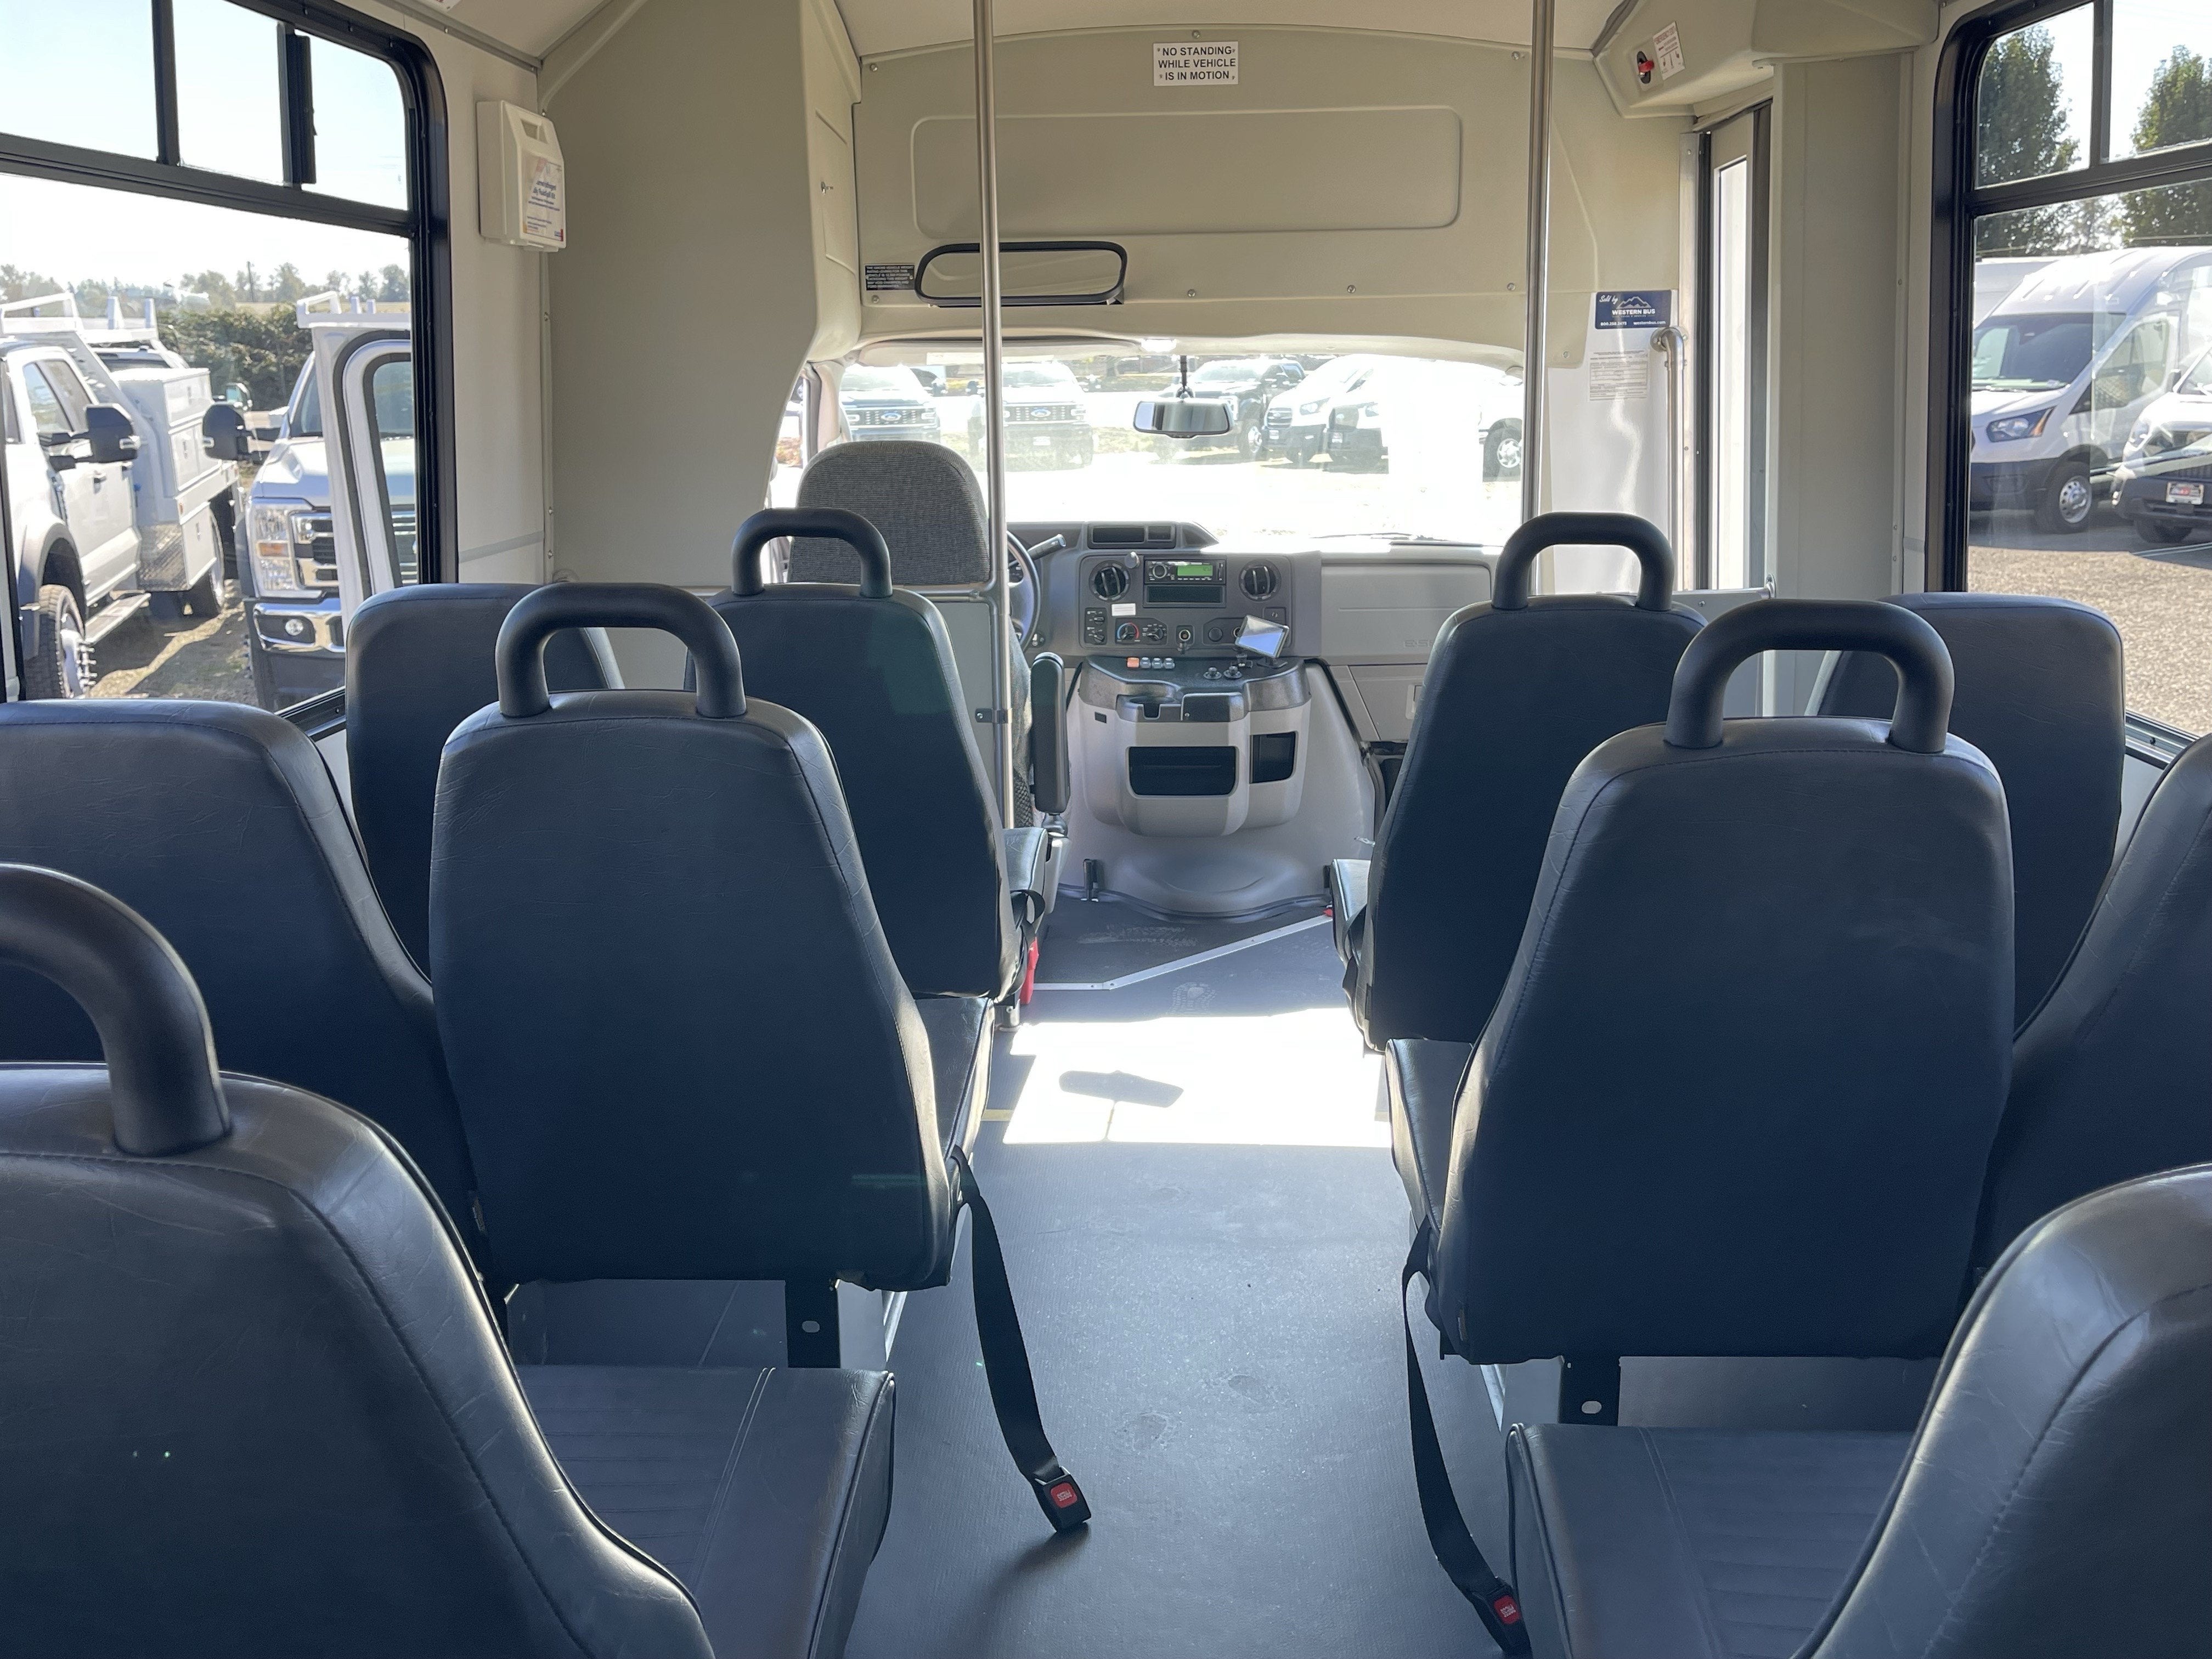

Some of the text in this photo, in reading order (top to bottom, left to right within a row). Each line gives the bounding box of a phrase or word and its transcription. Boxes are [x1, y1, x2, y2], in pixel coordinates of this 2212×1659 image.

[1163, 46, 1232, 56] NO STANDING
[1158, 58, 1236, 68] WHILE VEHICLE
[1165, 71, 1229, 80] IS IN MOTION
[1612, 295, 1618, 304] by
